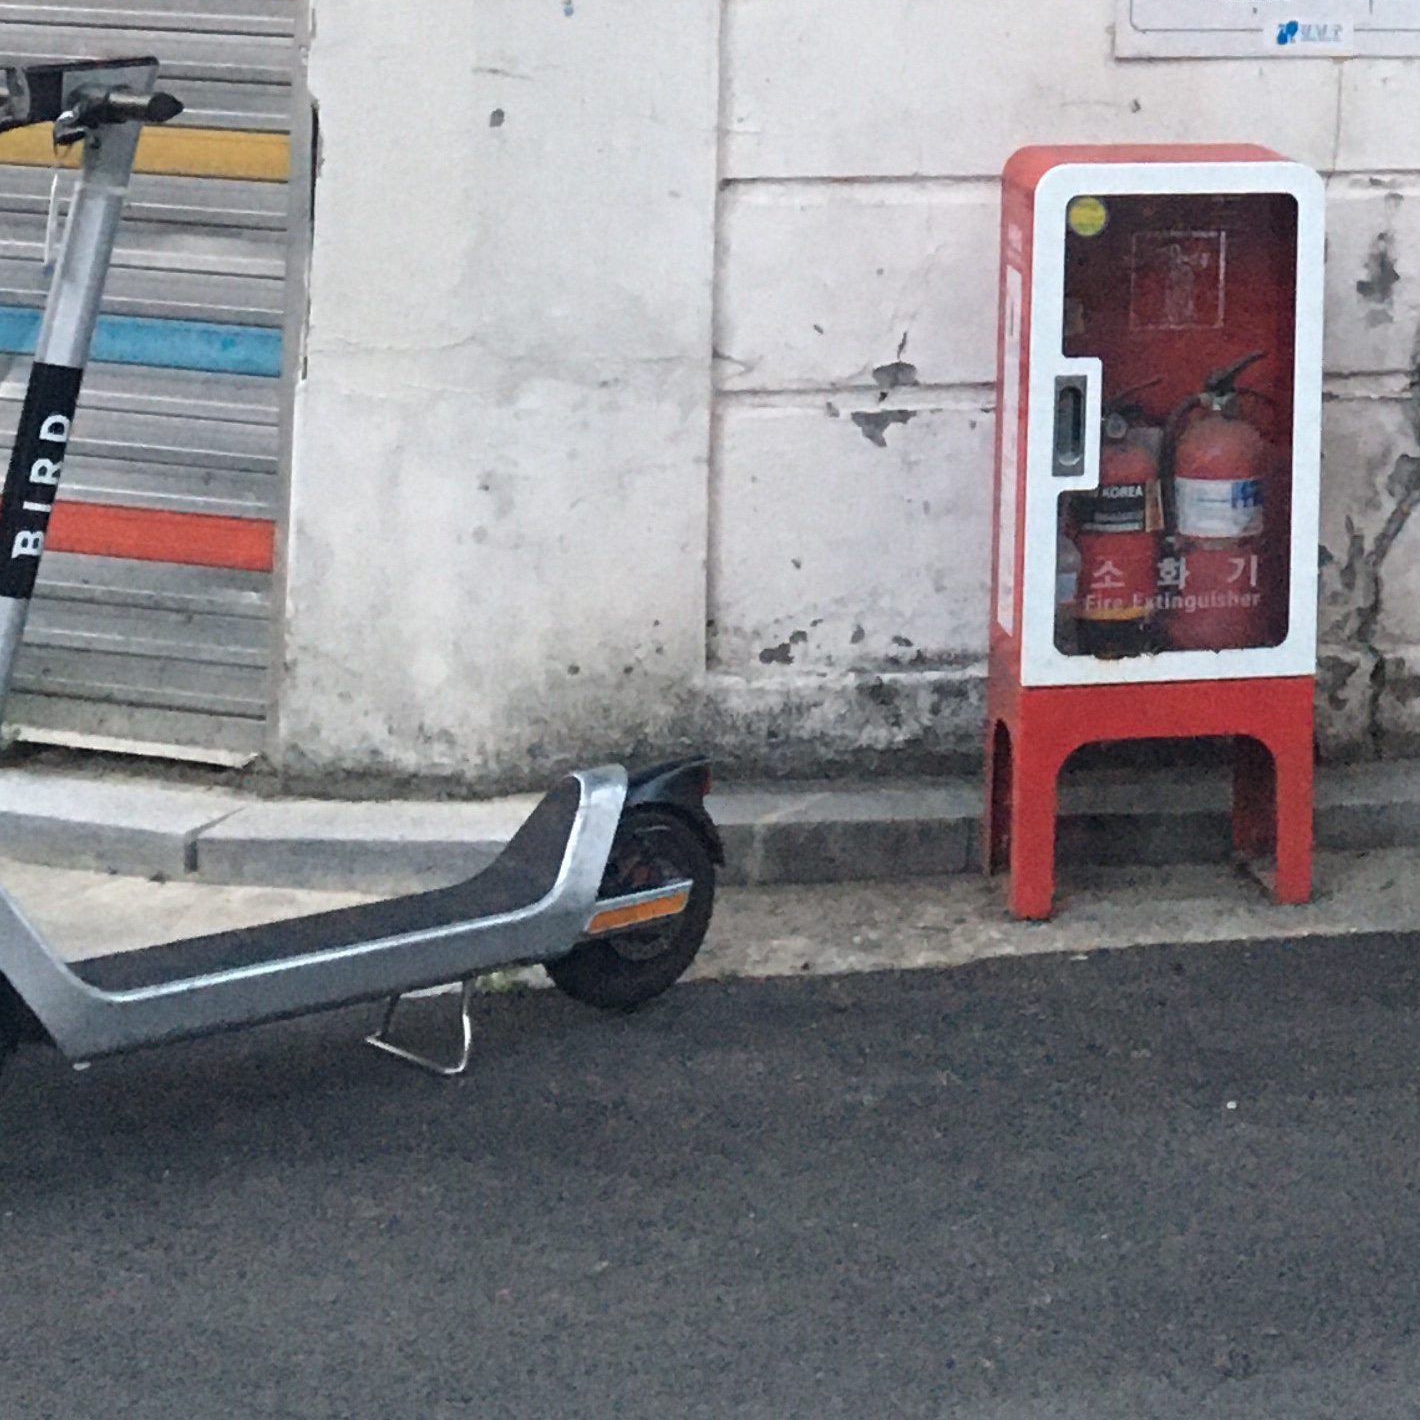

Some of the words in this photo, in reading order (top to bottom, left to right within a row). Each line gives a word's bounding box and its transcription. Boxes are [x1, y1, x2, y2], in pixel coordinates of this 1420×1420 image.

[12, 414, 70, 558] BIRD
[1085, 593, 1123, 612] Fire
[1132, 590, 1262, 613] Extinguisher
